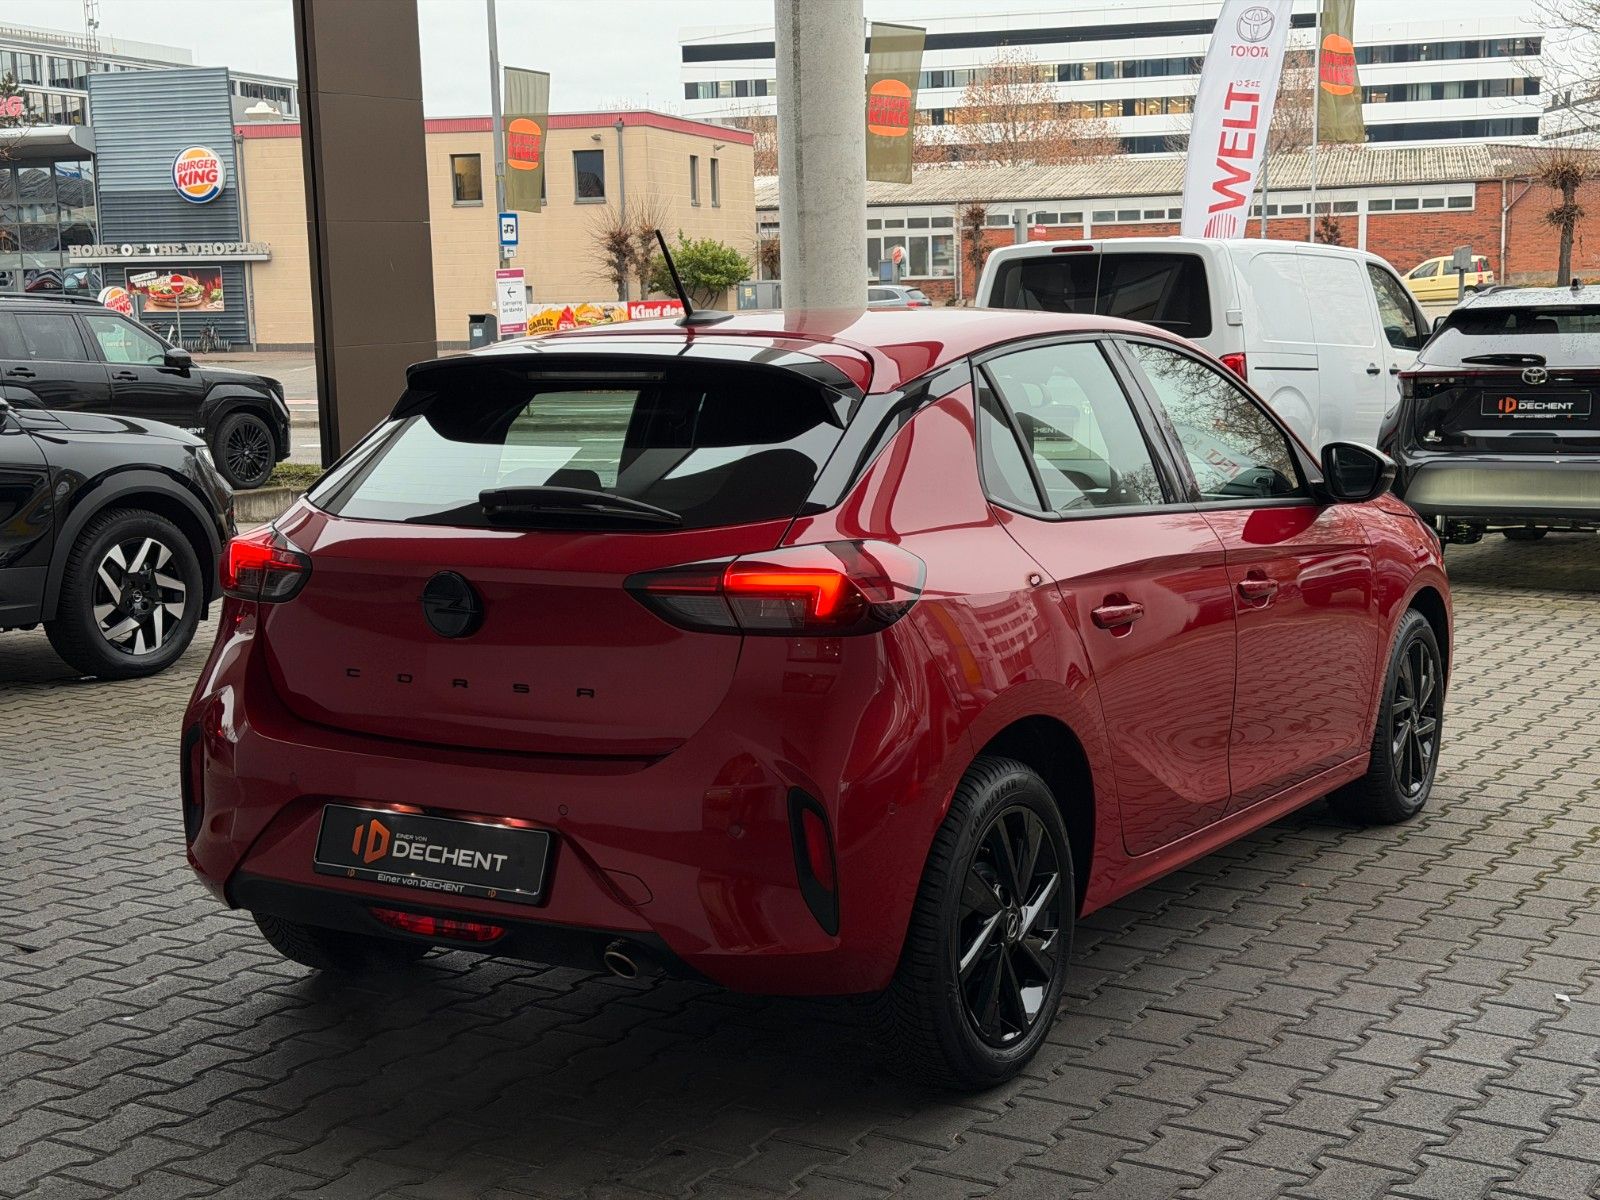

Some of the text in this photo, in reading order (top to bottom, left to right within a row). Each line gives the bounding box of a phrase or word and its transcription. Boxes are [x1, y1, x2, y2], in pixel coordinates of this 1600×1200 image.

[1230, 45, 1268, 57] TOYOTA
[1208, 82, 1260, 214] WELT
[177, 159, 217, 173] BURGER
[178, 169, 218, 187] KING
[67, 242, 270, 257] HOME OF THE WHOPPER
[630, 304, 662, 319] King
[528, 318, 554, 331] GARLIC
[1518, 402, 1574, 410] DECHENT
[346, 668, 595, 698] CORSA
[395, 832, 414, 841] EINER
[392, 840, 508, 872] DECHENT
[377, 873, 465, 893] Einer von DECHENT
